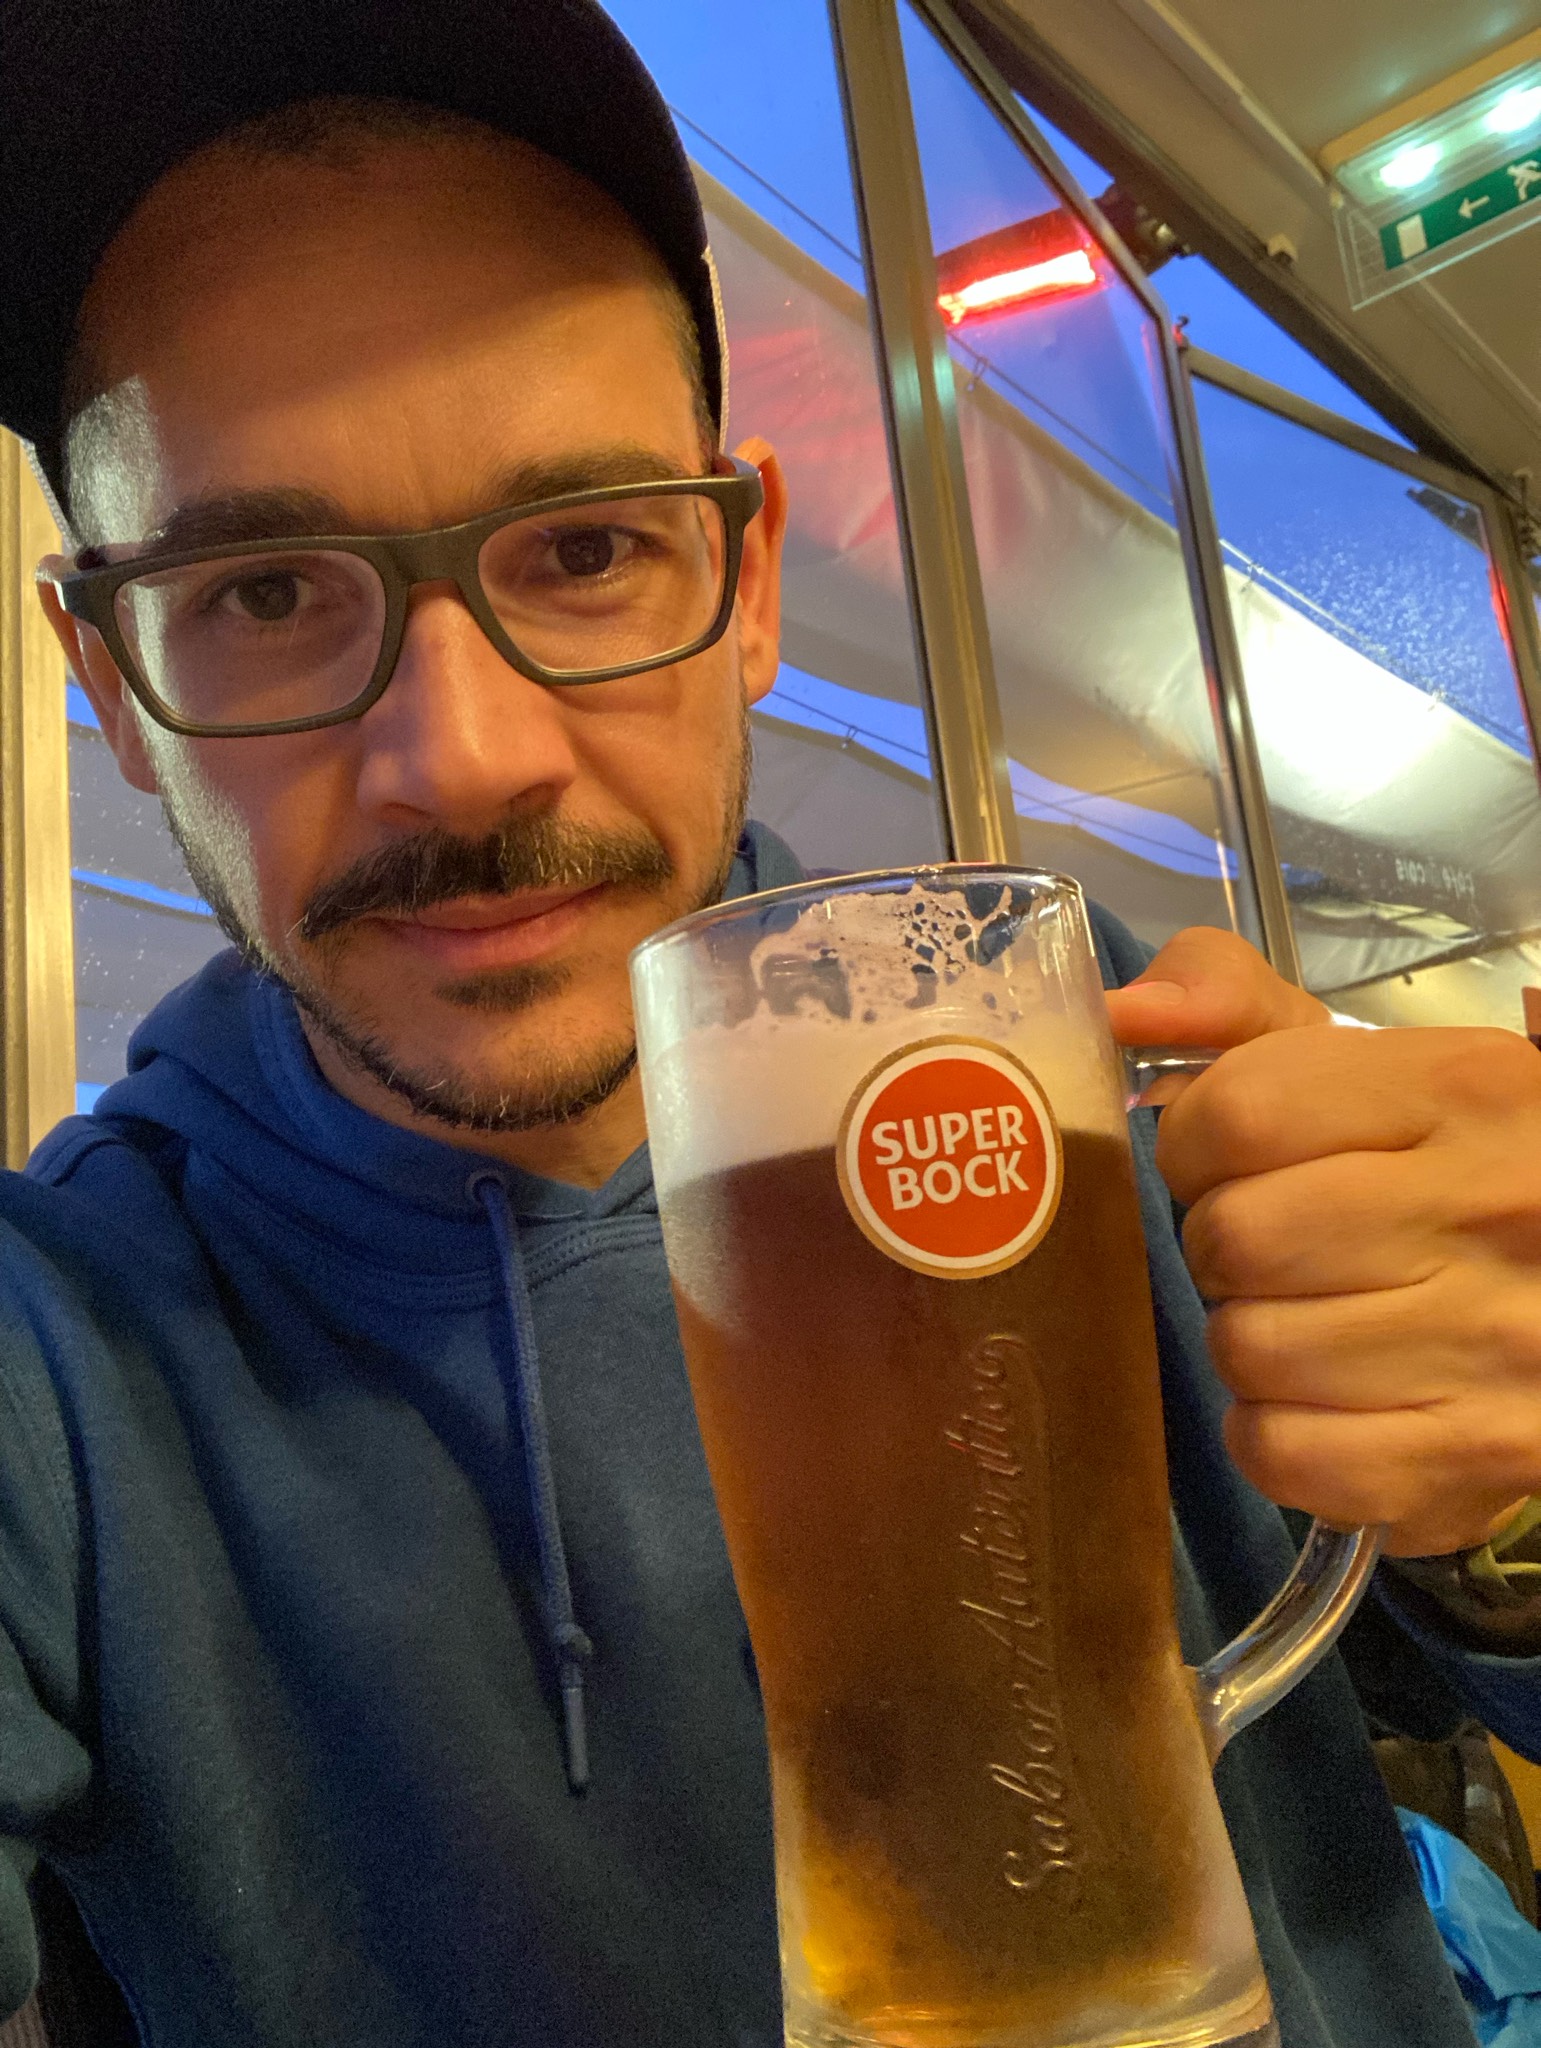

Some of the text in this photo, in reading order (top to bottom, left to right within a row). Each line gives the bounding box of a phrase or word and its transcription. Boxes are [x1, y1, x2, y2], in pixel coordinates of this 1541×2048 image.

[871, 1104, 1029, 1166] SUPER
[887, 1150, 1030, 1211] BOCK
[986, 1681, 1074, 1890] Sabor
